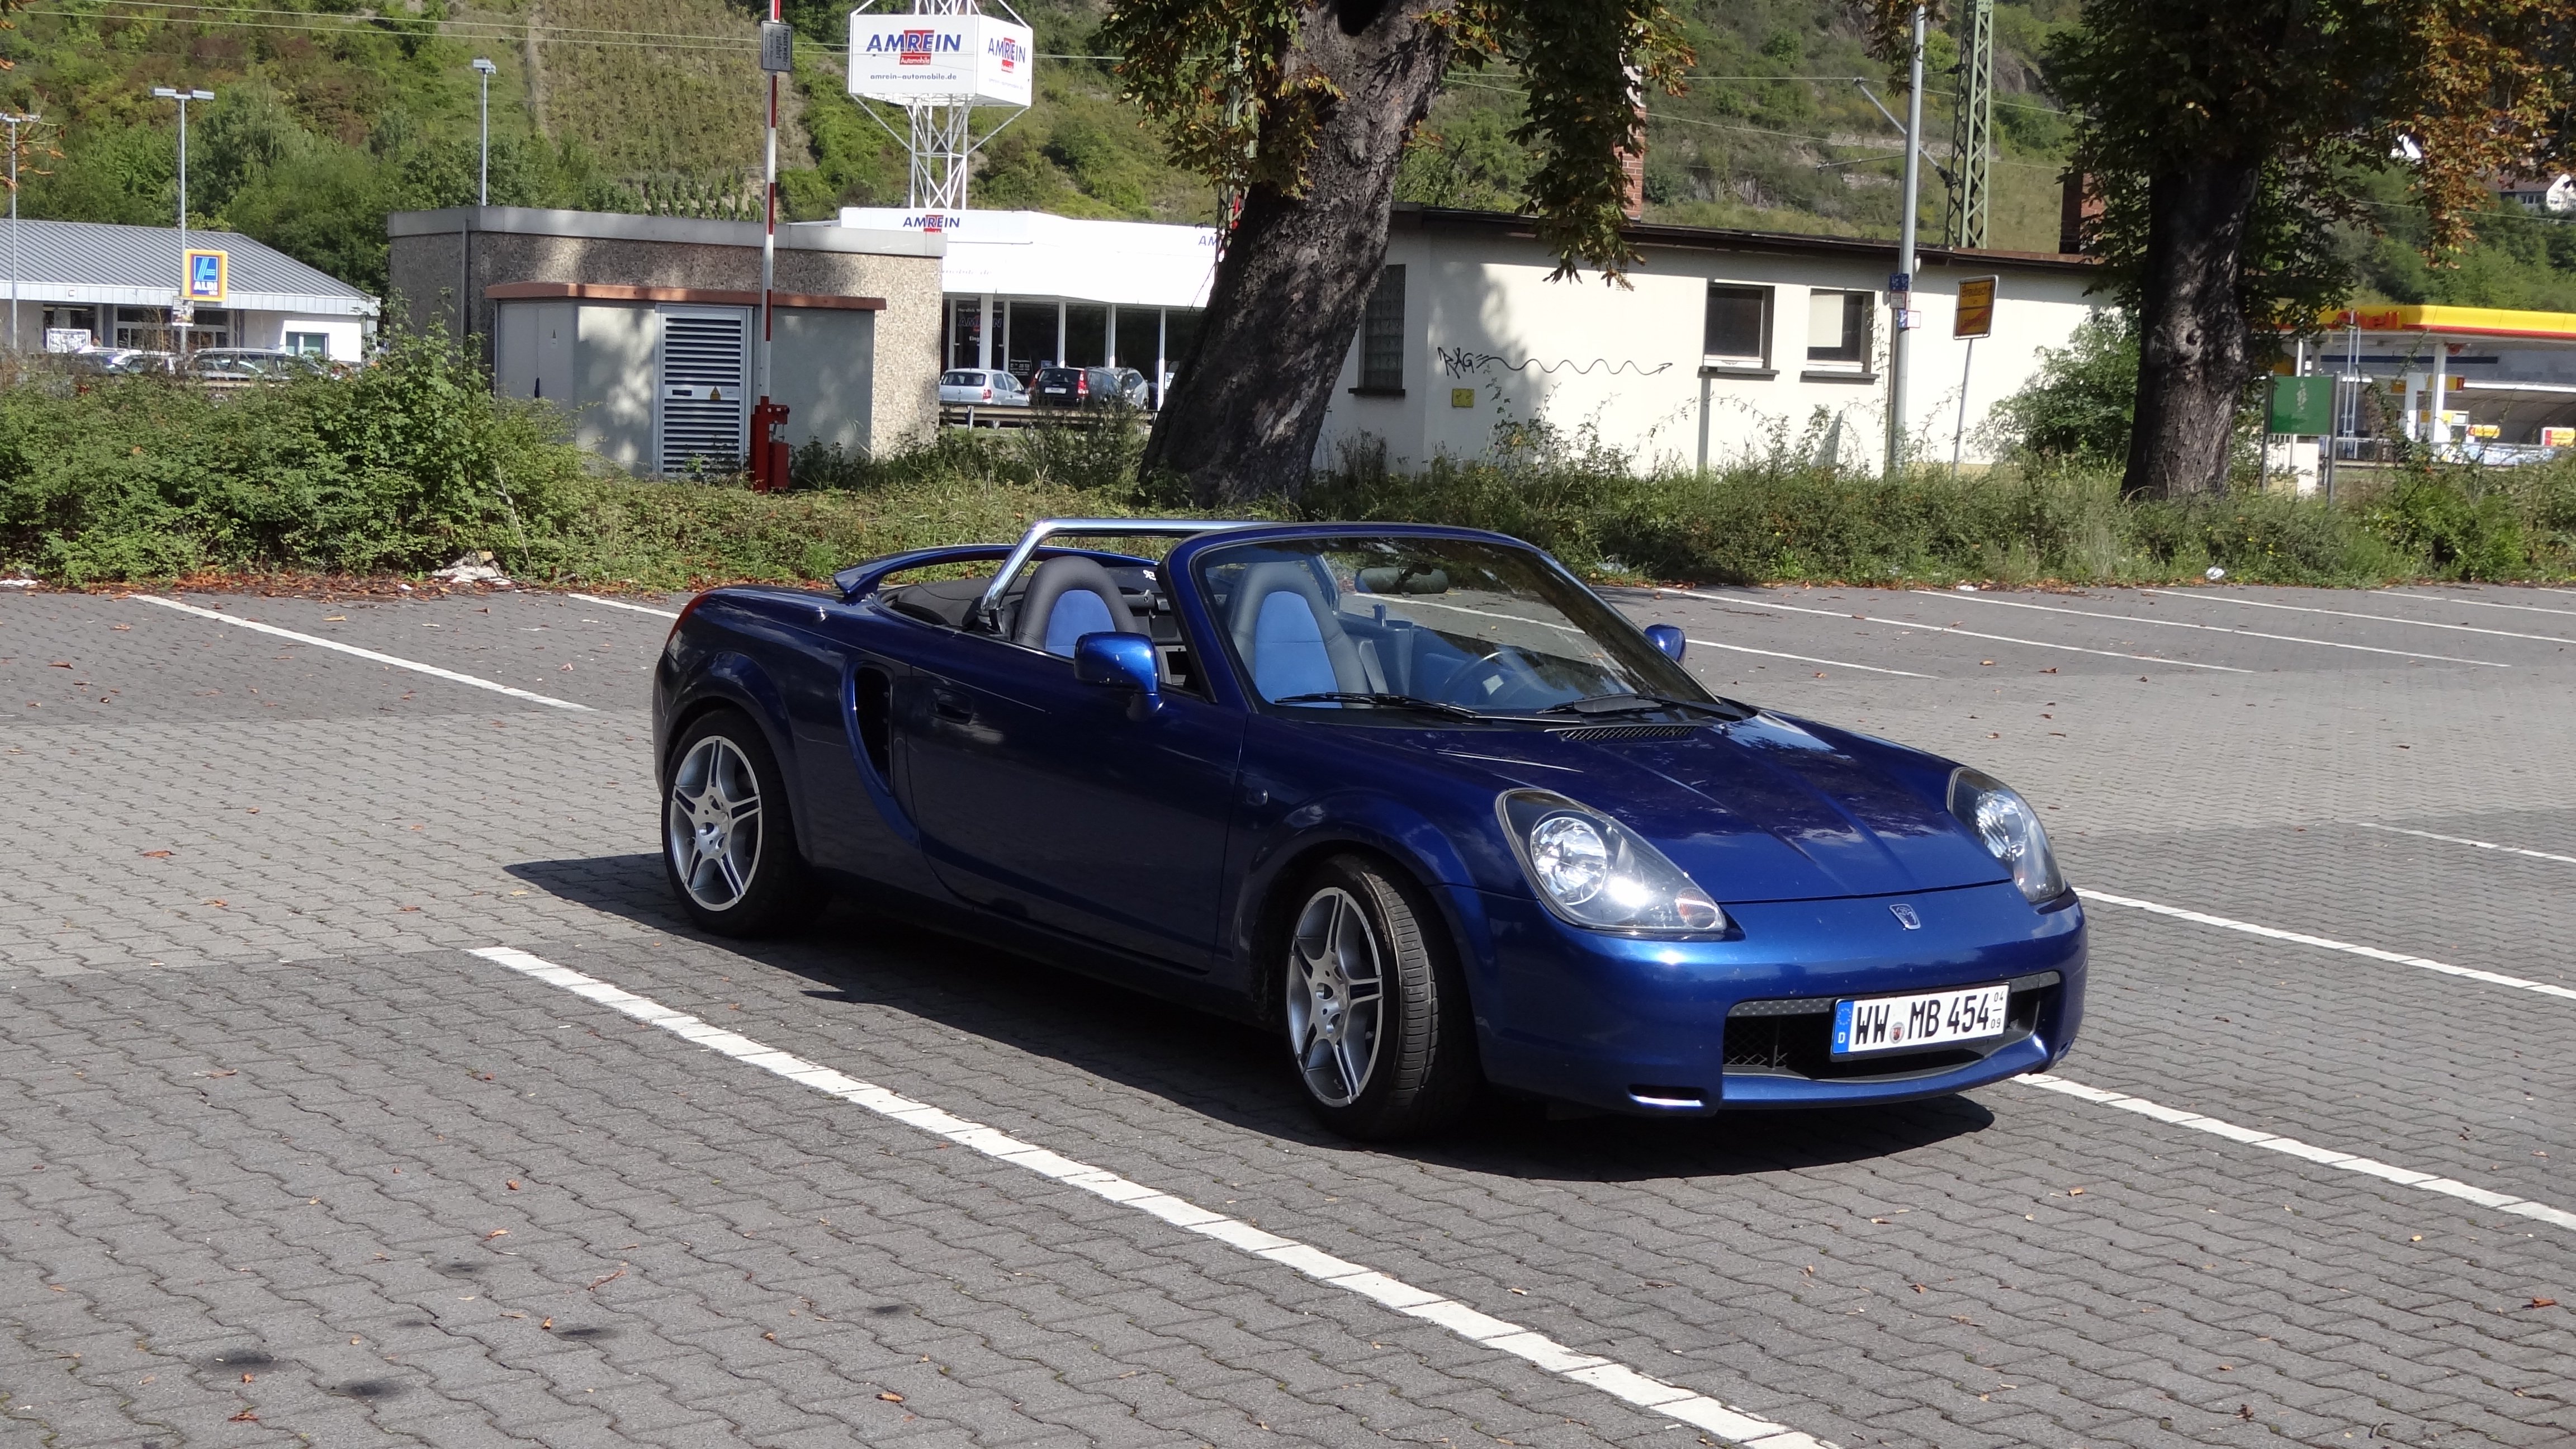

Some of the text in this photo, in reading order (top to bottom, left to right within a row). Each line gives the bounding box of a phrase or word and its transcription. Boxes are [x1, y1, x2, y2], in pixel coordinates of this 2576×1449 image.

[866, 34, 962, 52] AMREIN
[988, 37, 1026, 64] AMREIN
[903, 216, 960, 228] AMREIN
[193, 281, 218, 291] ALDI
[1993, 991, 2004, 1001] 04
[1855, 993, 1989, 1045] WW MB 454
[1991, 1018, 2001, 1029] 09
[1838, 1032, 1845, 1044] D
